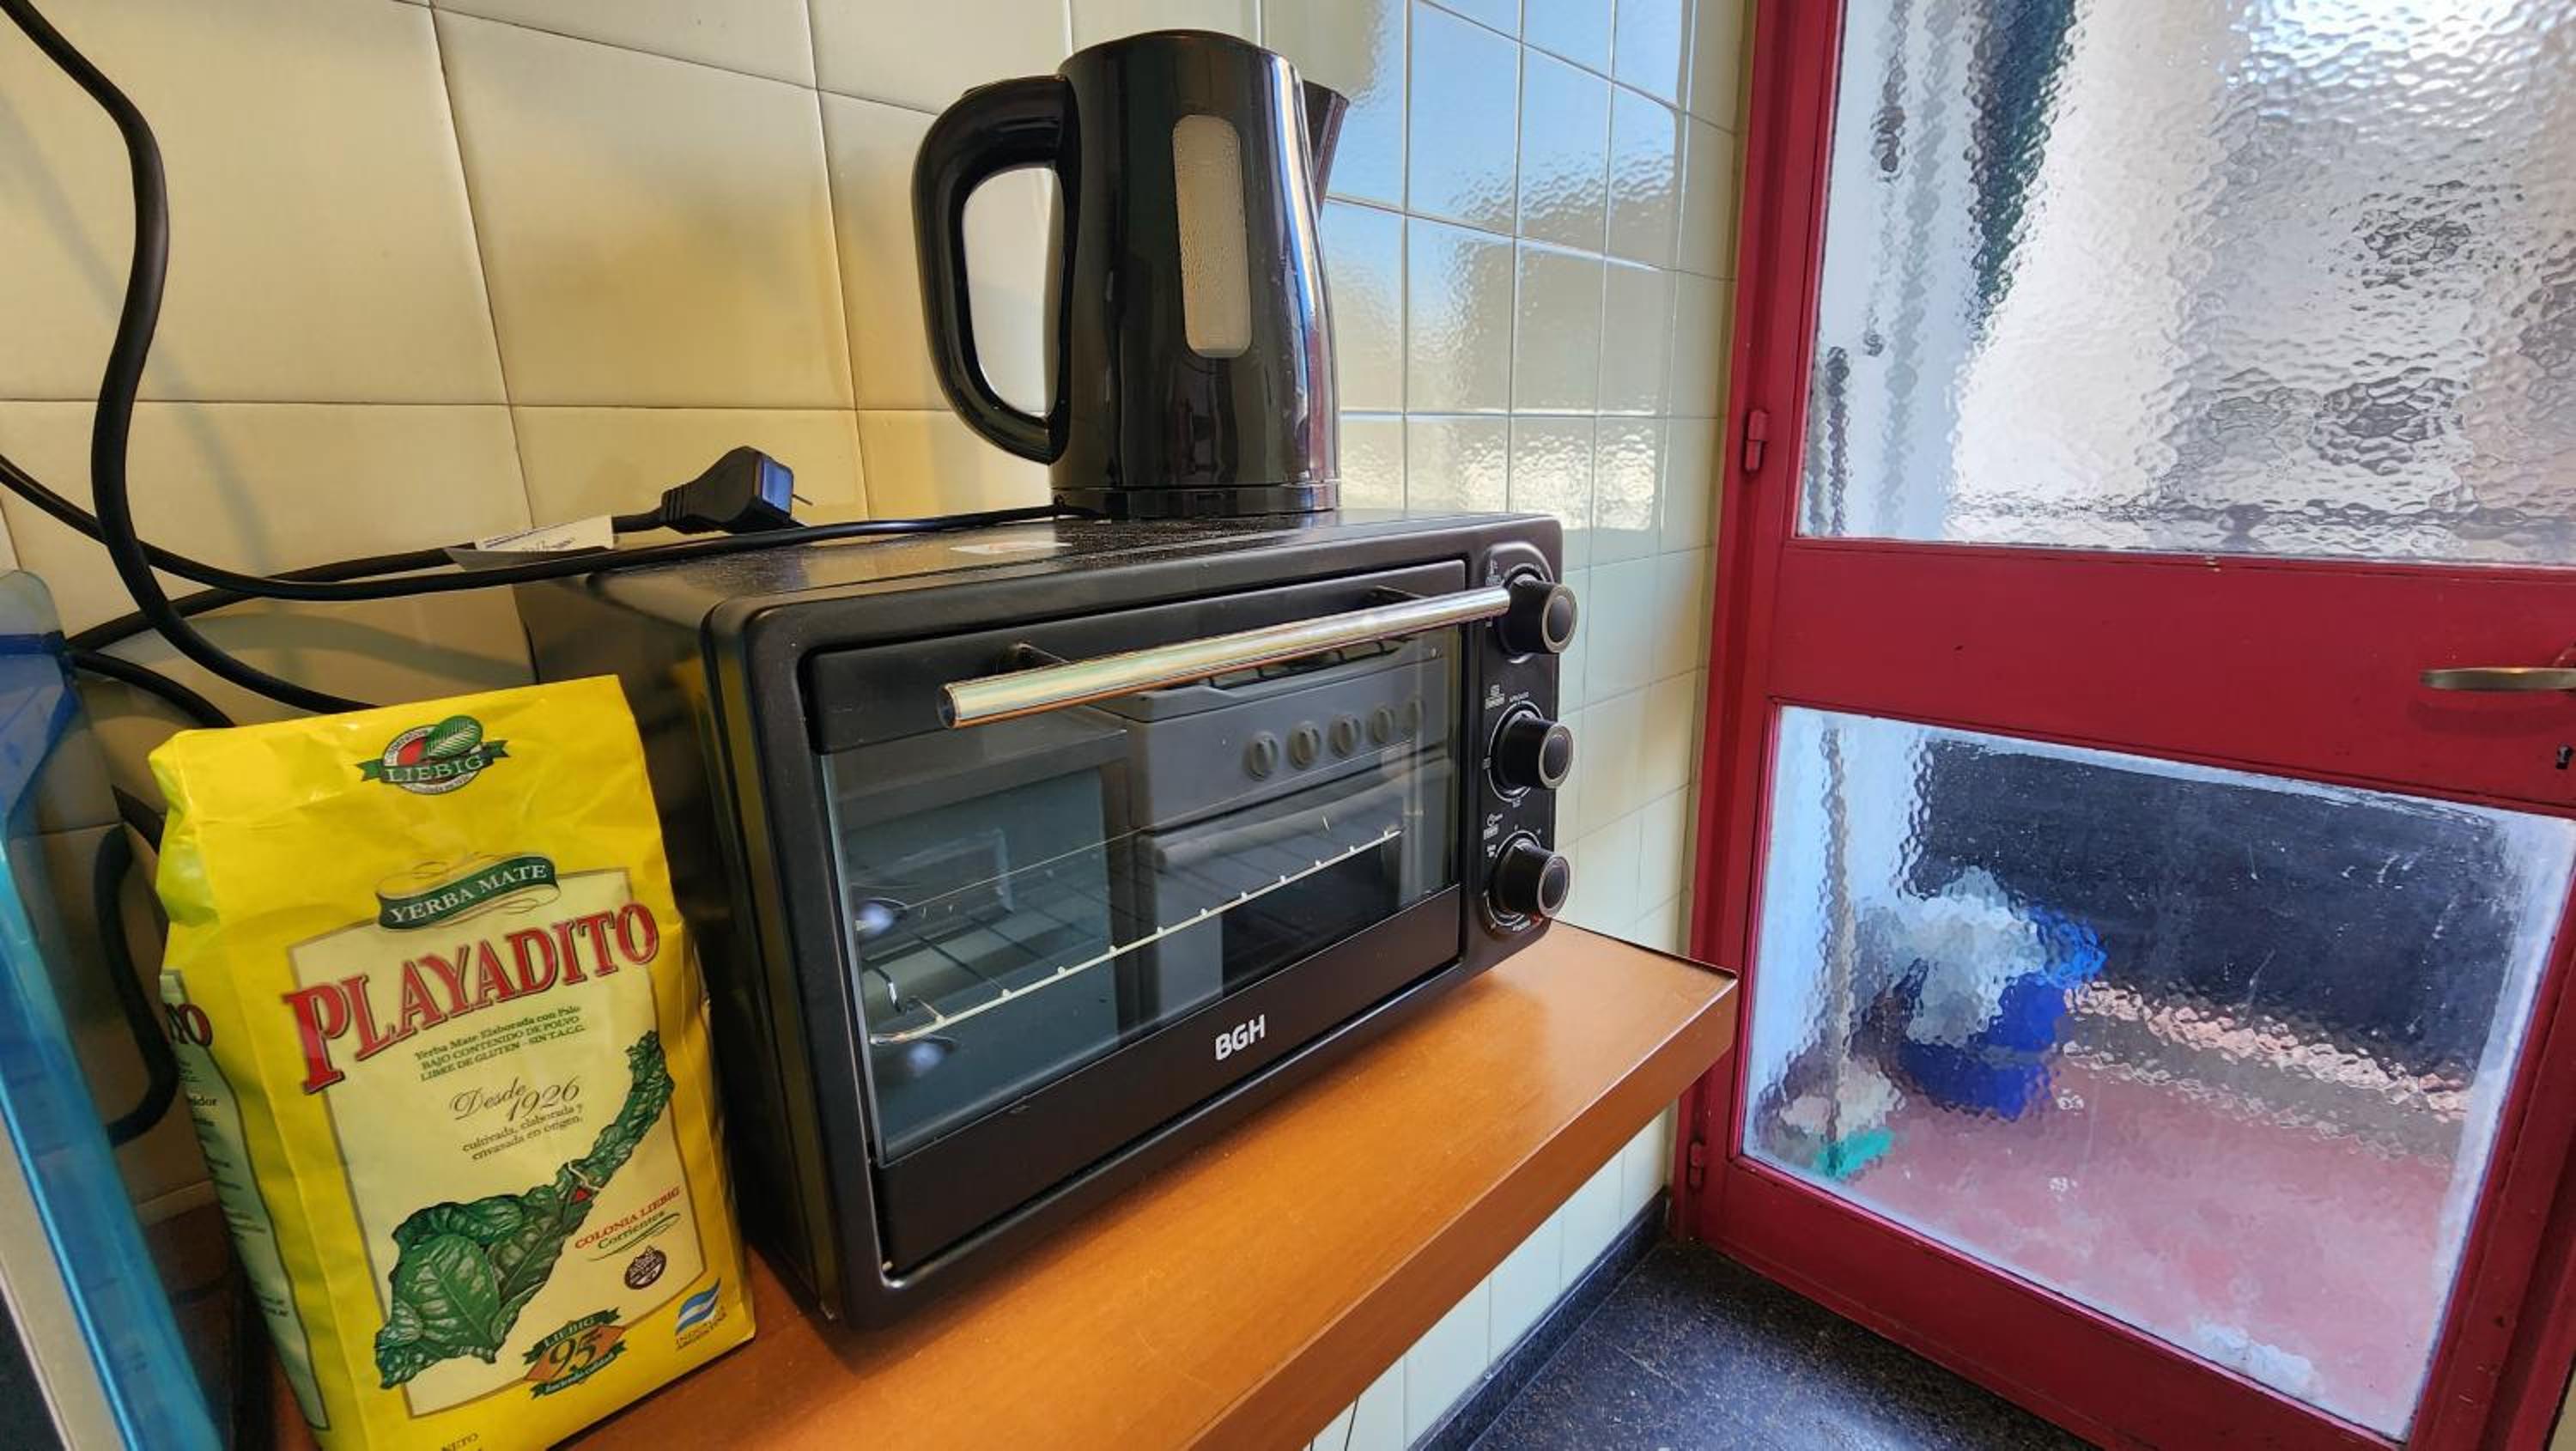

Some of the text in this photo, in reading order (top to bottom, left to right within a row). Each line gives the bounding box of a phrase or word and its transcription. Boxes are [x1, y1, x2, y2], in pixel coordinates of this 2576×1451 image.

[387, 755, 483, 781] LIEBIG
[389, 864, 549, 923] YERBA MATE
[283, 903, 659, 1095] PLAYADITO
[415, 1044, 448, 1061] Yerba
[450, 1035, 477, 1050] Mate
[481, 1017, 535, 1038] Elaborada
[536, 1011, 556, 1023] con
[420, 1065, 456, 1082] LIBRE
[457, 1056, 474, 1069] DE
[475, 1041, 521, 1063] GLUTEN
[528, 1035, 547, 1046] SIN
[421, 1016, 580, 1071] BAJO CONTENIDO DE POLVO
[1215, 1014, 1265, 1060] BGH
[449, 1076, 526, 1120] Desde
[507, 1075, 580, 1121] 1926
[519, 1104, 574, 1130] elaborada
[471, 1136, 525, 1159] envasada
[526, 1129, 542, 1139] en
[574, 1186, 680, 1249] COLONIA LIEBIG
[598, 1211, 665, 1249] Corrientes
[544, 1317, 594, 1347] LIEBIG
[550, 1327, 603, 1378] 95
